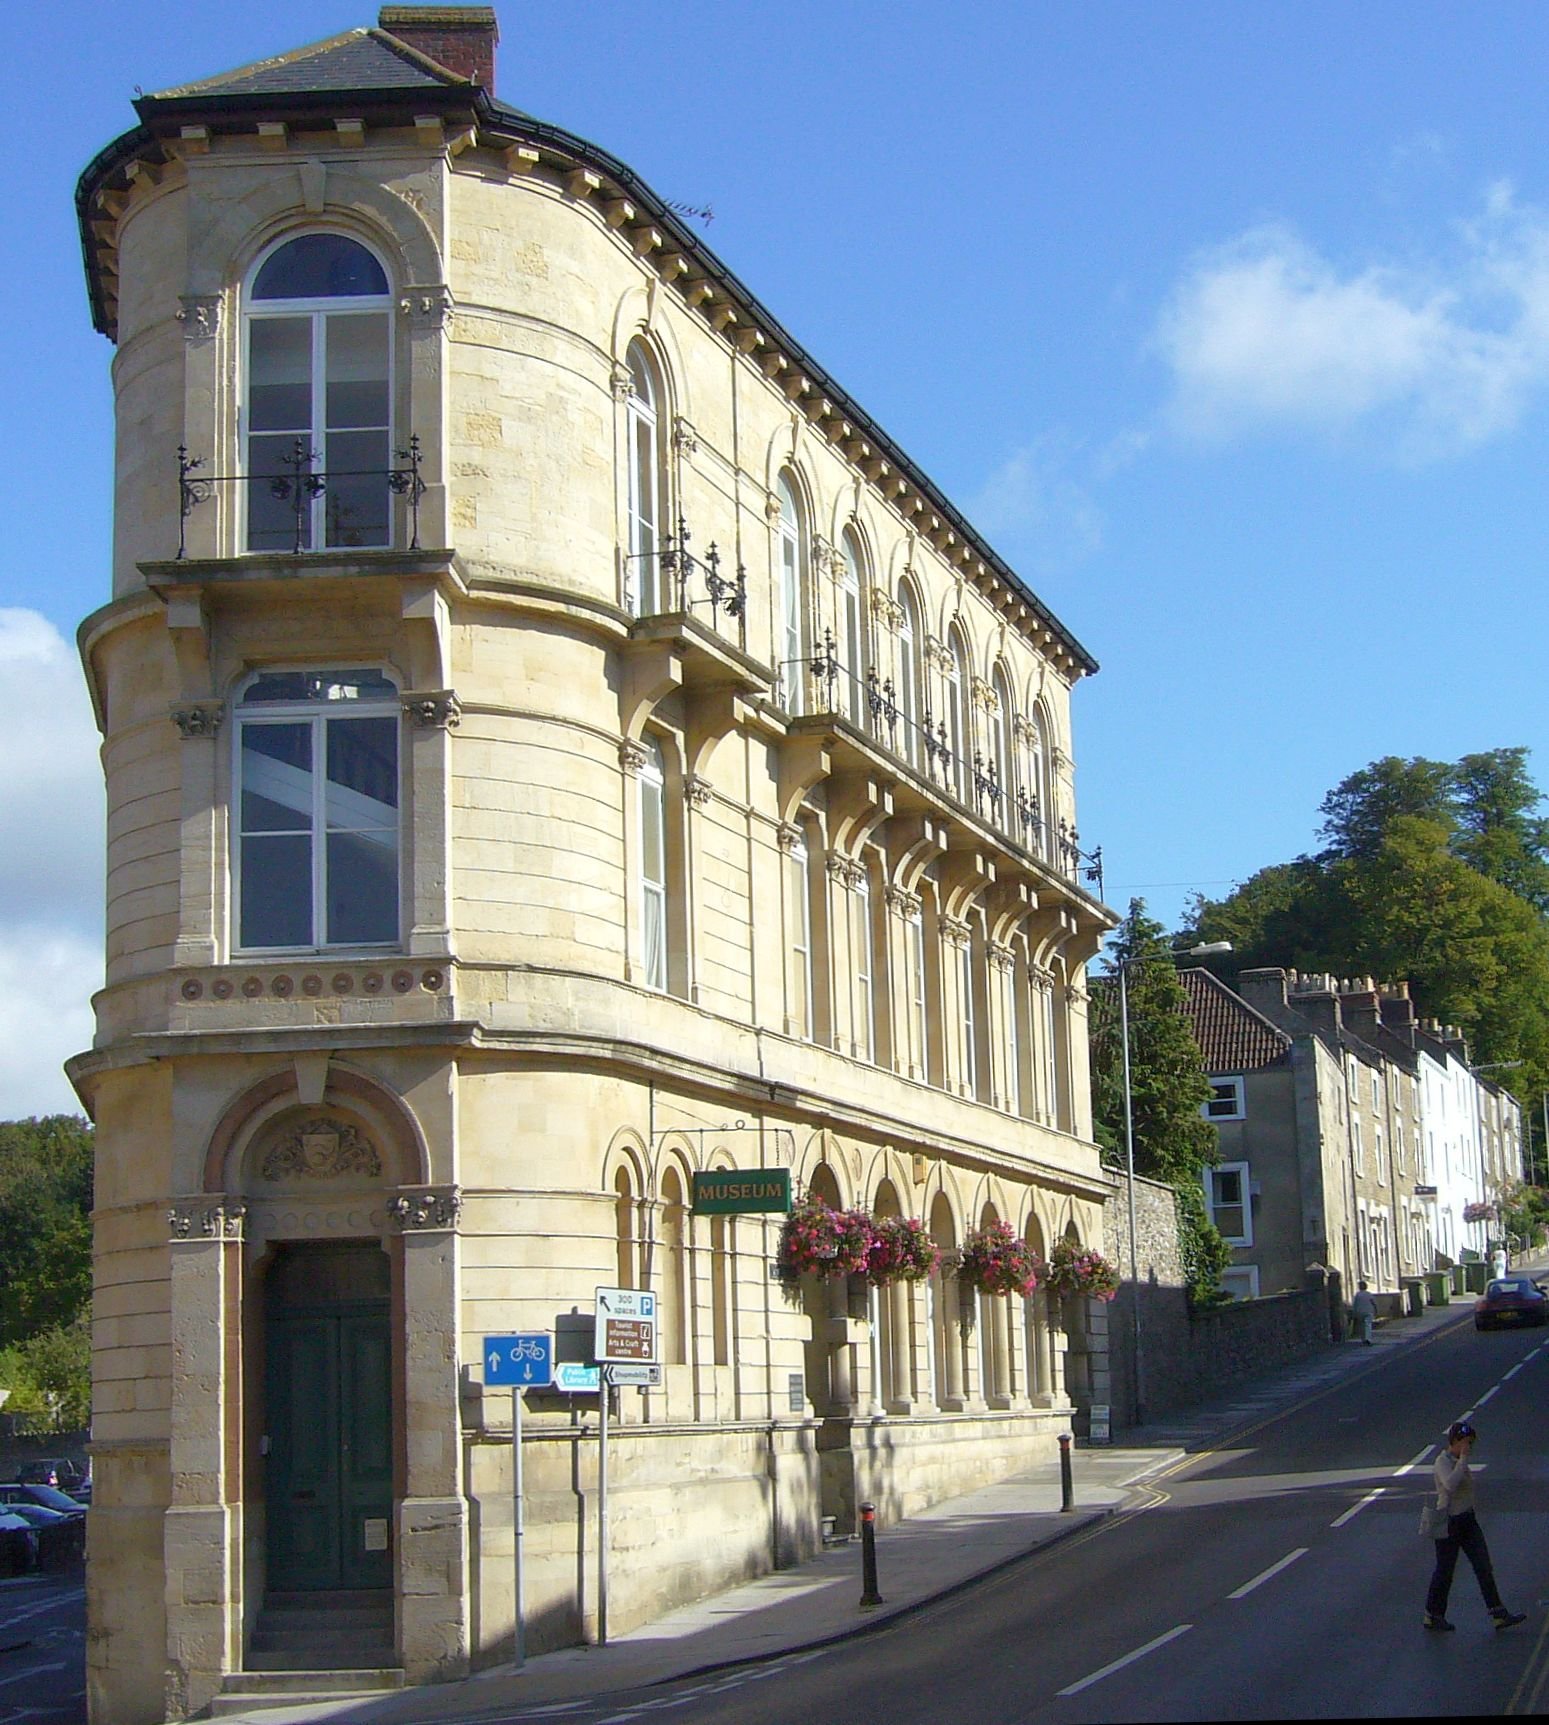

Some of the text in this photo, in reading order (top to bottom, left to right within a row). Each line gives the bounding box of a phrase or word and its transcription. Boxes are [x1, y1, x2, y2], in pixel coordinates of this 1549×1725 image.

[699, 1183, 782, 1200] MUSEUM
[618, 1294, 632, 1304] 300
[614, 1307, 636, 1315] spaces
[615, 1320, 633, 1329] Tourist
